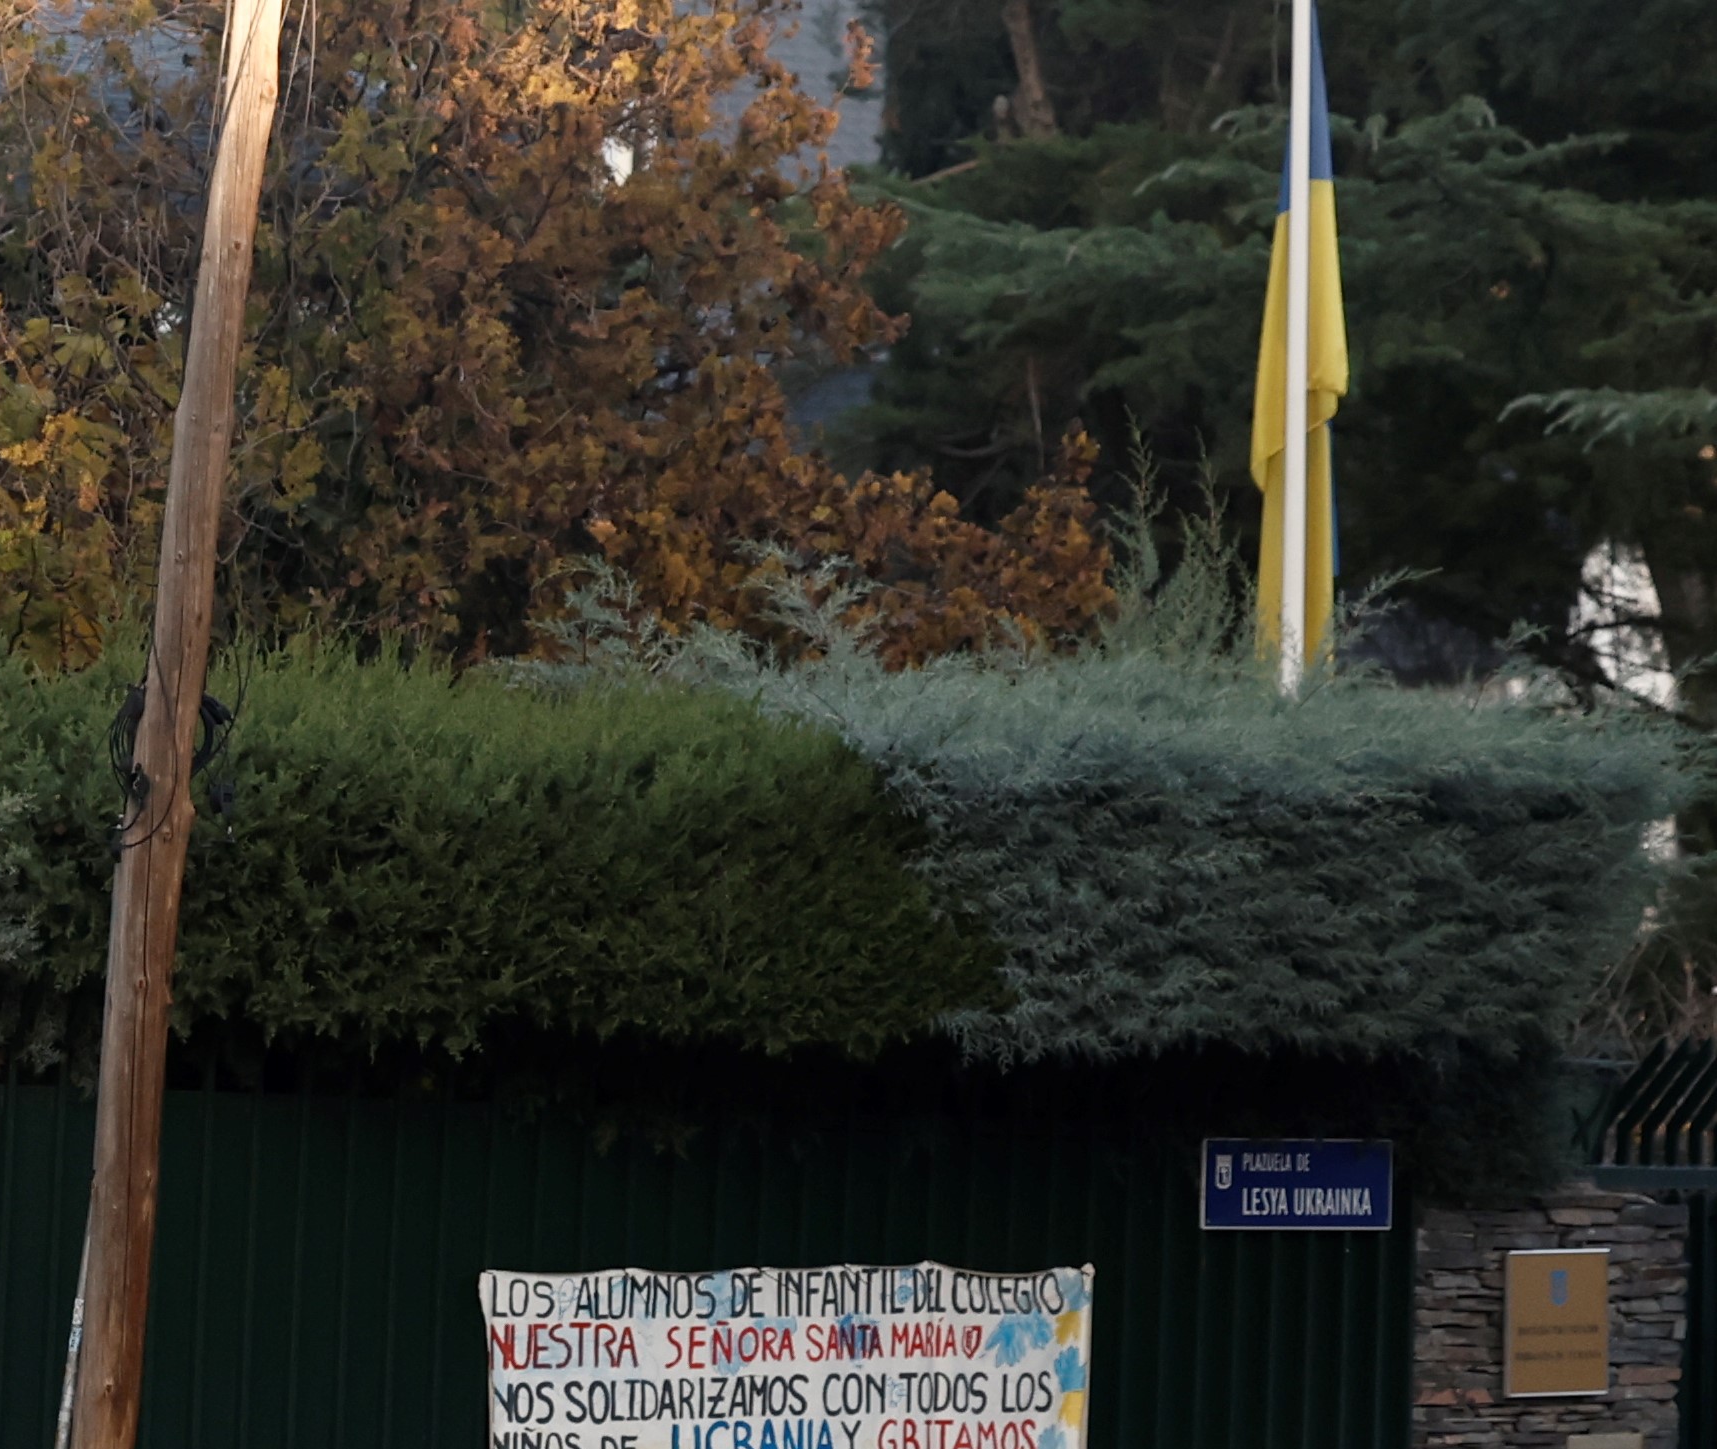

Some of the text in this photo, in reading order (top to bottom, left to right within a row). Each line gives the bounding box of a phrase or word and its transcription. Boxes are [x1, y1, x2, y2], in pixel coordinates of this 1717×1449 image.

[1242, 1152, 1310, 1172] PLAZUELA DE
[1242, 1187, 1373, 1216] LESYA UKRAINKA
[492, 1267, 1064, 1319] LOS ALUMNOS DE INFANTIL DEL COLEGIO
[489, 1317, 958, 1370] NUESTRA SEÑORA SANTA MARÍA
[492, 1370, 1054, 1424] NOS SOLIDARIZAMOS CON TODOS LOS
